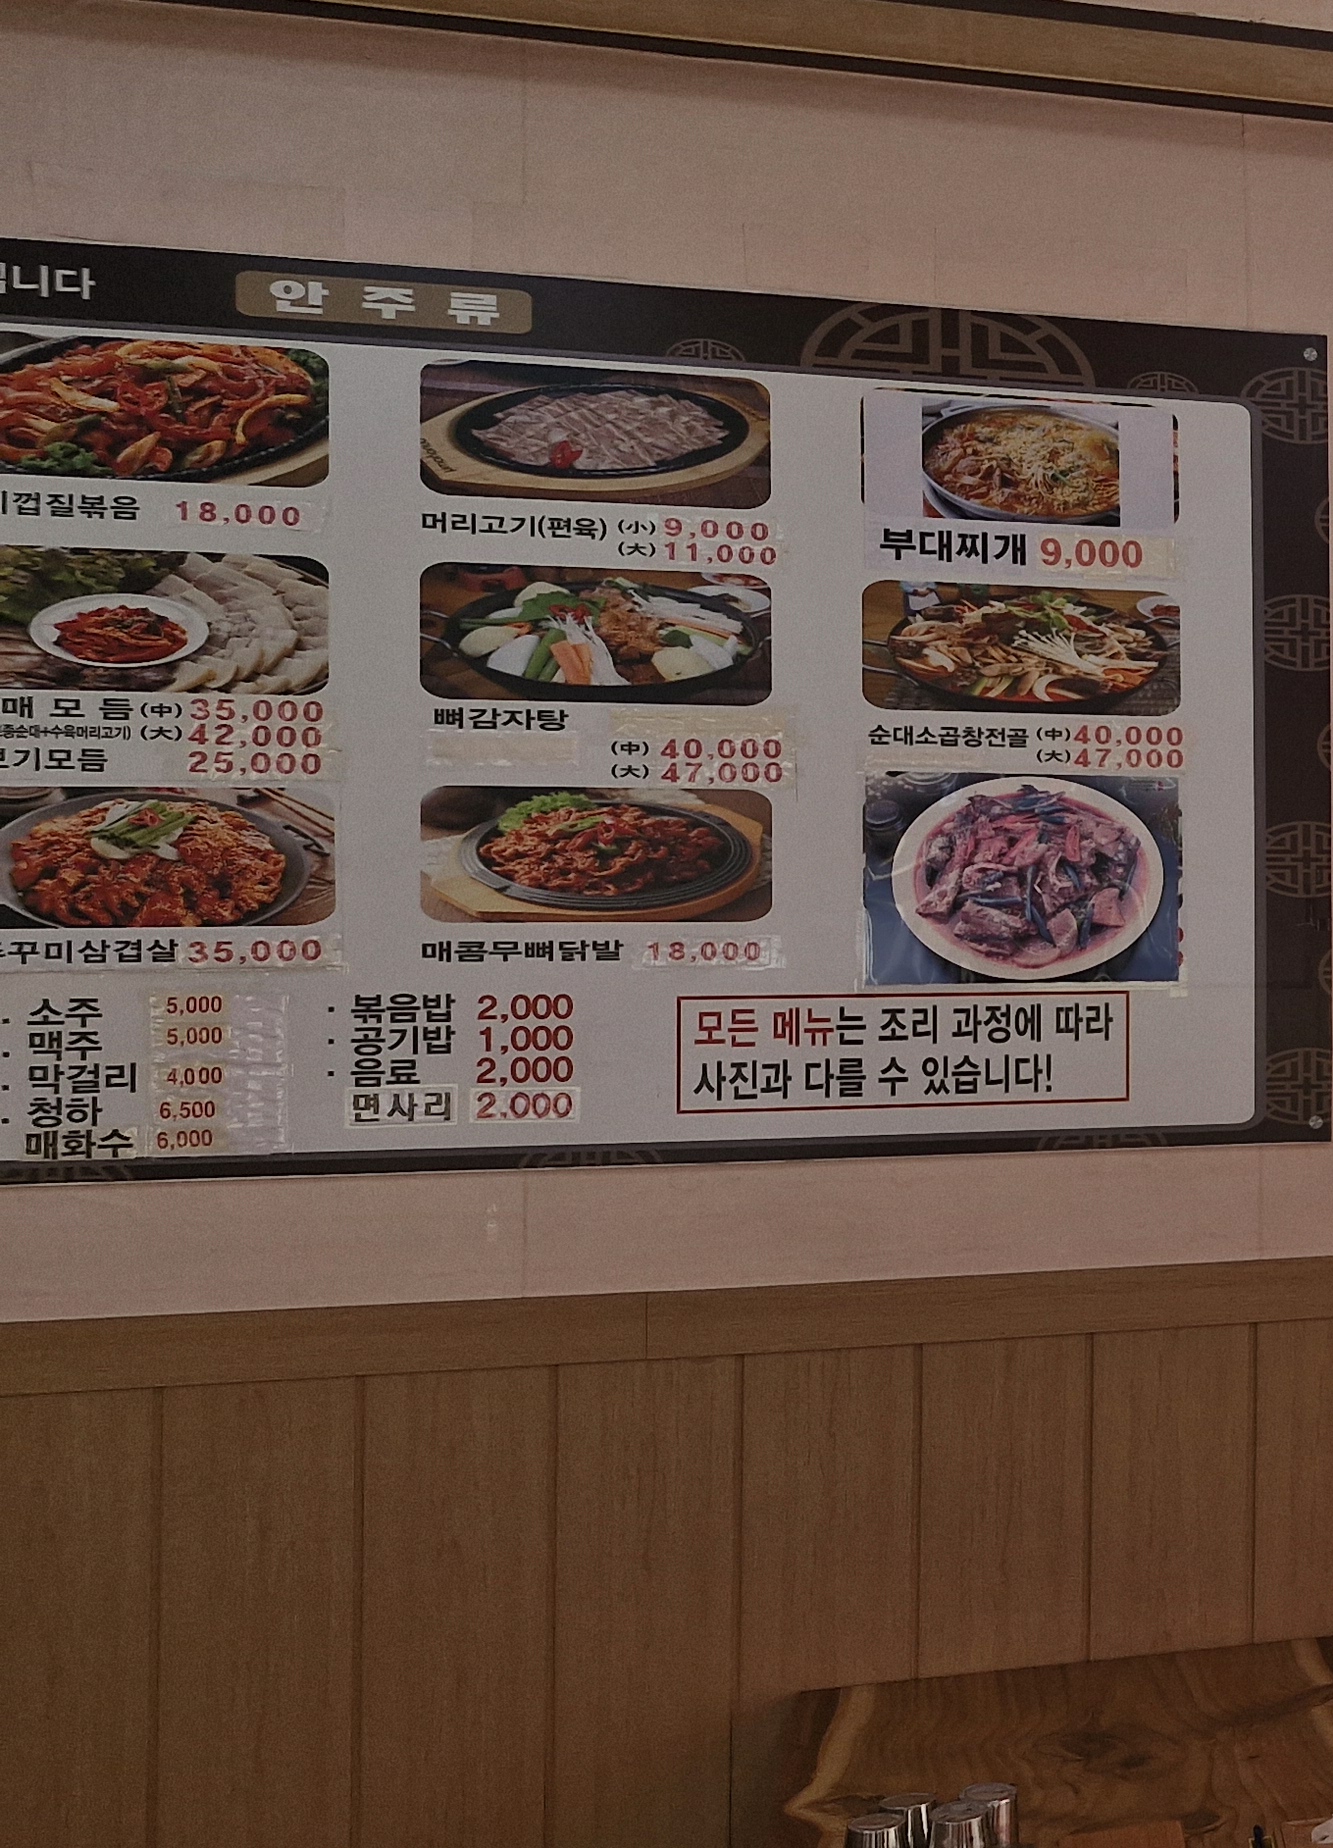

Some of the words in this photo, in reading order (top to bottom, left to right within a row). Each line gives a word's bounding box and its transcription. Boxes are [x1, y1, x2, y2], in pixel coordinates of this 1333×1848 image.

[0, 262, 96, 300] 니다
[176, 500, 301, 527] 18,000
[421, 512, 608, 541] 머리고기(편육)
[663, 517, 769, 541] 9,000
[664, 542, 777, 566] 11,000
[880, 527, 1028, 566] 부대찌개
[1039, 537, 1144, 570] 9,000
[190, 699, 324, 723] 35,000
[434, 707, 569, 732] 뼈감자탕
[188, 724, 322, 748] 42,000
[660, 739, 782, 761] 40,000
[868, 724, 1029, 748] 순대소곱창전골
[1074, 725, 1184, 747] 40,000
[188, 751, 322, 775] 25,000
[1074, 749, 1184, 769] 47,000
[660, 763, 783, 785] 47,000
[0, 938, 179, 965] 꾸미삼겹살
[187, 939, 322, 964] 35,000
[421, 940, 625, 963] 매콤무뼈닭발
[647, 941, 762, 962] 18,000
[27, 998, 103, 1028] 소주
[166, 996, 223, 1015] 5,000
[350, 993, 456, 1024] 볶음밥
[477, 993, 574, 1023] 2,000
[694, 1009, 759, 1047] 모든
[773, 1008, 867, 1046] 메뉴는
[878, 1006, 939, 1044] 조리
[951, 1004, 1042, 1043] 과정에
[1055, 1002, 1114, 1042] 따라
[27, 1030, 103, 1061] 맥주
[166, 1026, 223, 1046] 5,000
[350, 1025, 456, 1056] 공기밥
[479, 1024, 574, 1055] 1,000
[28, 1062, 137, 1095] 막걸리
[166, 1067, 223, 1086] 4,000
[350, 1057, 421, 1088] 음료
[476, 1055, 574, 1087] 2,000
[693, 1061, 792, 1101] 사진과
[804, 1060, 868, 1098] 다를
[878, 1059, 909, 1096] 수
[922, 1053, 1054, 1094] 있습니다!
[27, 1096, 103, 1128] 청하
[159, 1100, 216, 1121] 6,500
[25, 1128, 134, 1160] 매화수
[157, 1129, 213, 1150] 6,000
